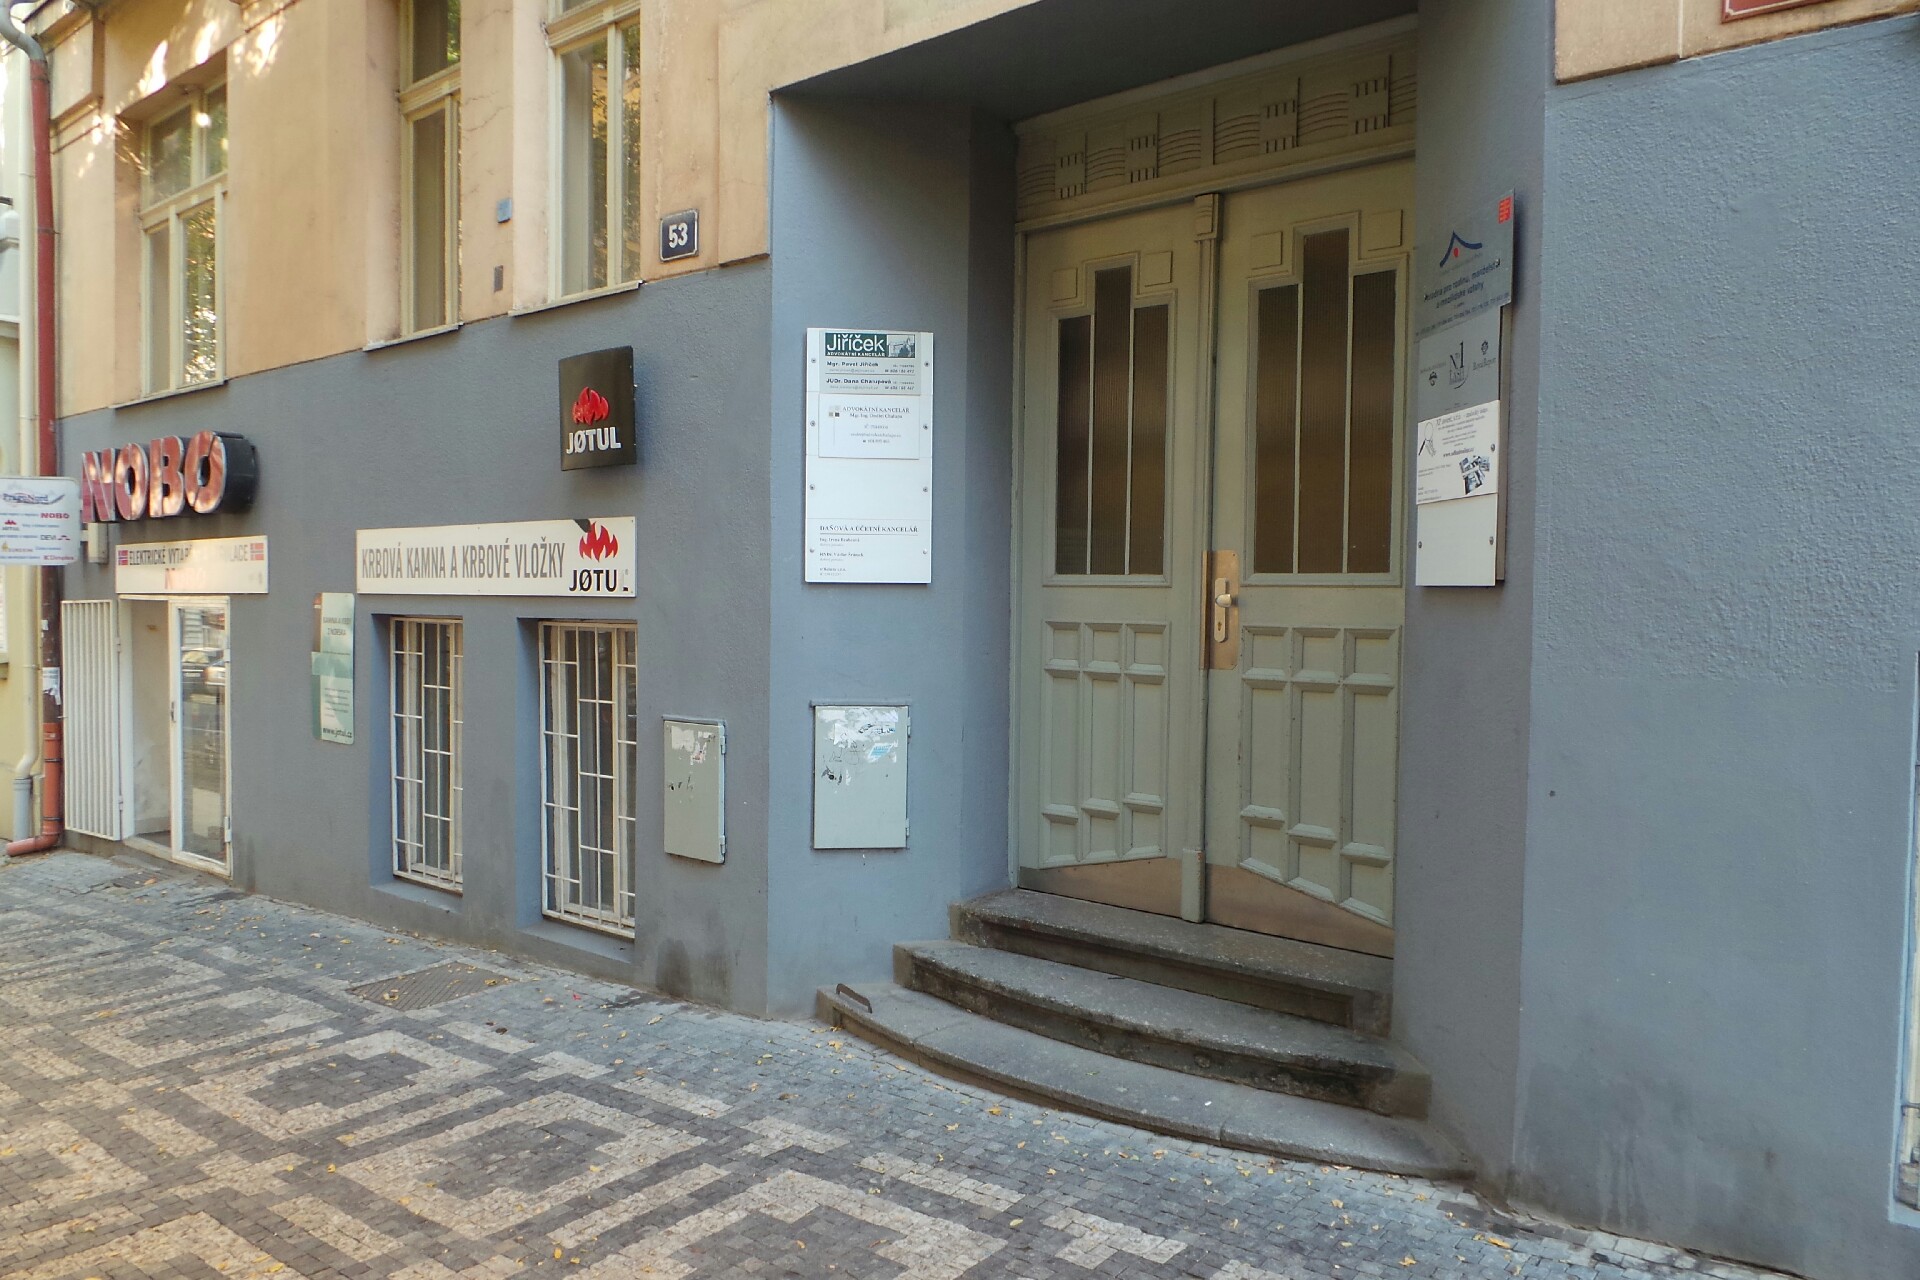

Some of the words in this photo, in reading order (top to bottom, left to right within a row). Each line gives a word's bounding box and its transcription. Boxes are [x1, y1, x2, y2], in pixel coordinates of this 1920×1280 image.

[668, 222, 688, 248] 53
[826, 334, 885, 352] Jiříček
[566, 426, 622, 454] JØTUL
[82, 430, 226, 523] NOBO
[129, 546, 166, 565] ELEKTRICKÉ
[361, 542, 403, 578] KRBOVÁ
[406, 546, 446, 578] KAMNA
[450, 545, 458, 578] A
[462, 537, 510, 578] KRBOVÉ
[514, 536, 566, 578] VLOŽKY
